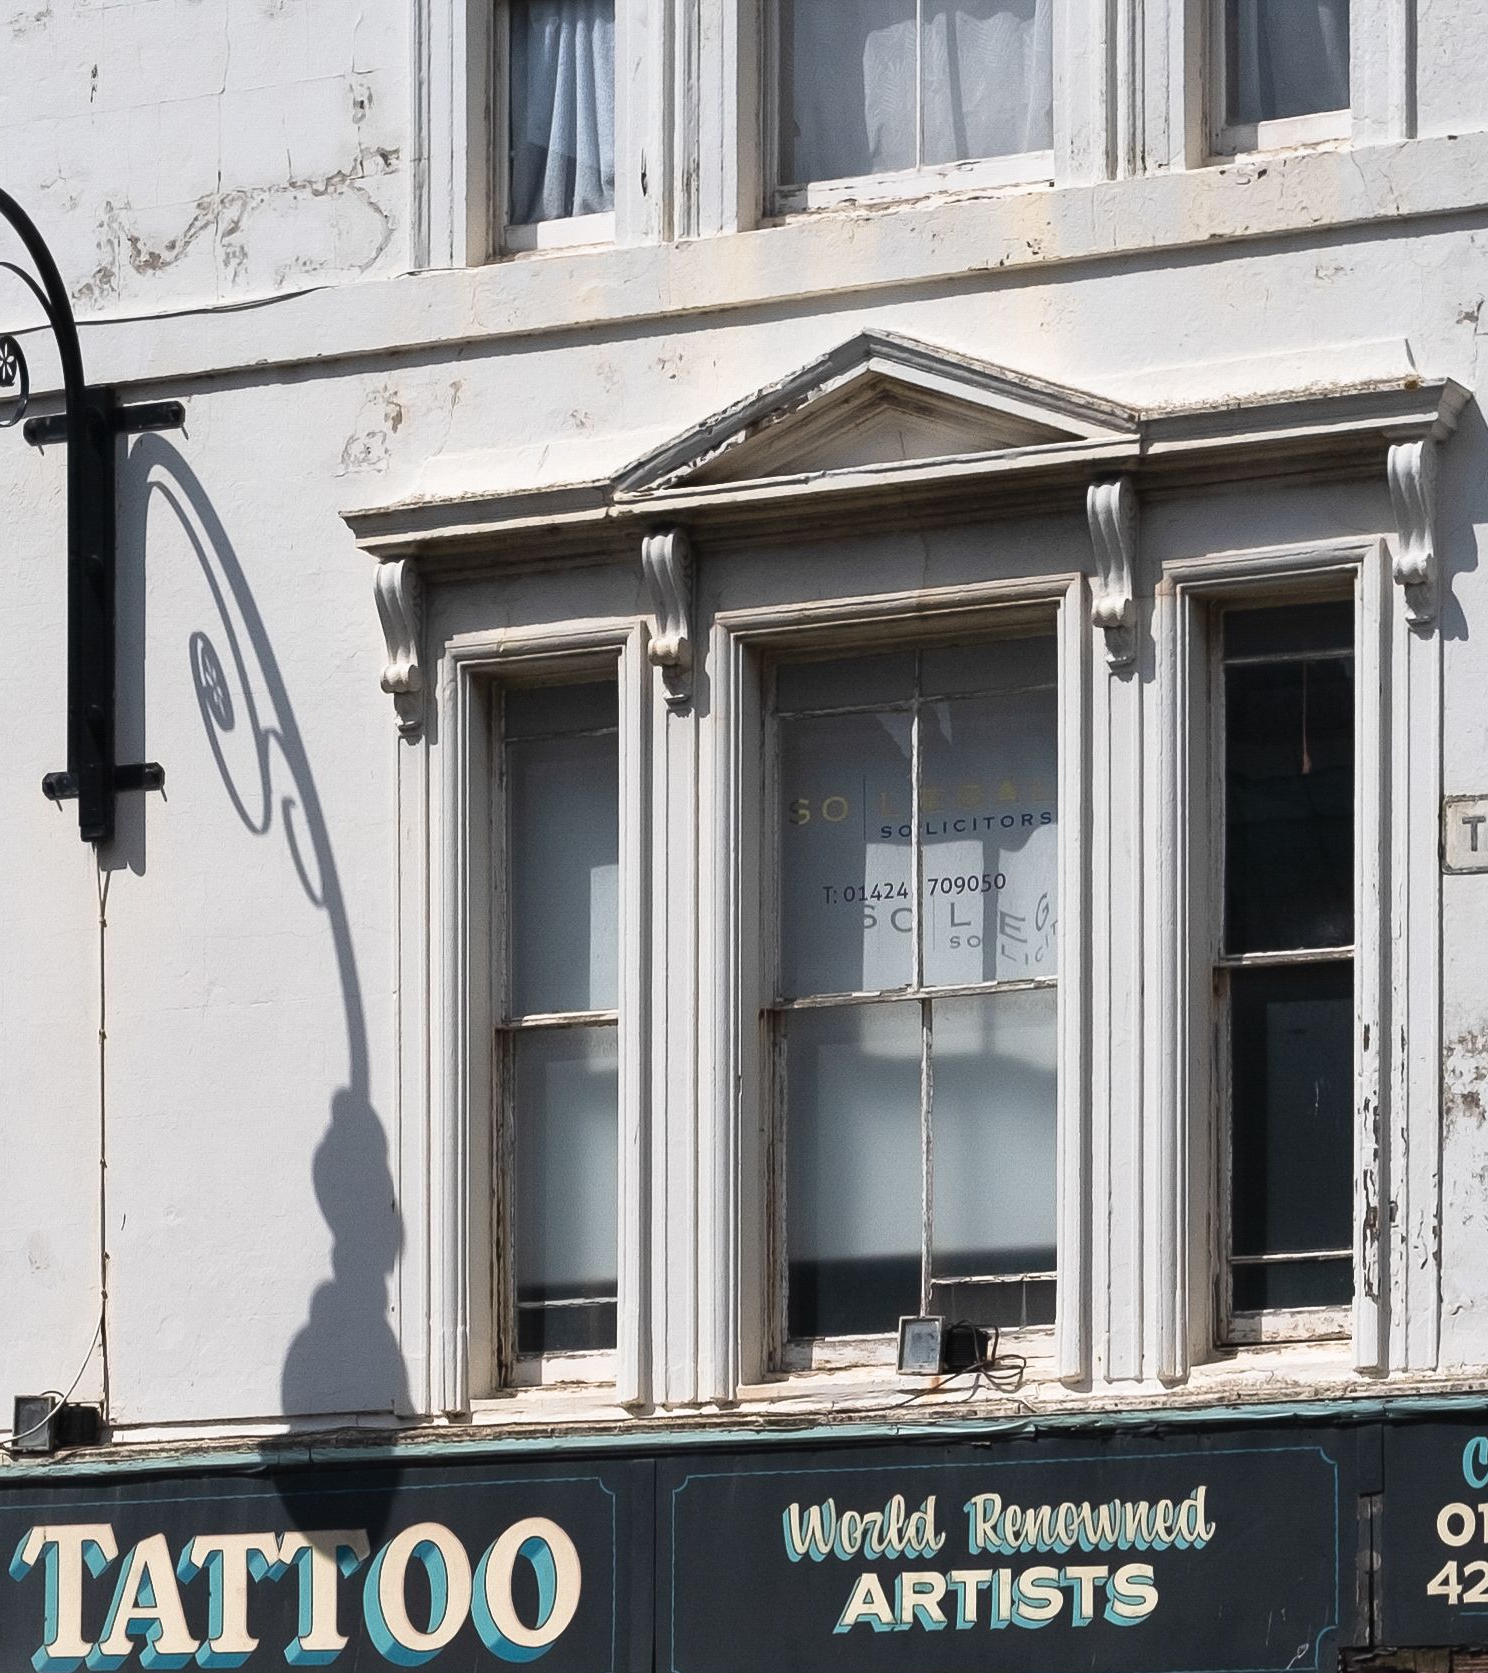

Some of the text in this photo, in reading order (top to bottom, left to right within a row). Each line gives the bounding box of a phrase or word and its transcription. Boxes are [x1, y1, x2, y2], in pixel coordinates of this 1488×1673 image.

[880, 811, 1052, 839] SOLICITORS
[843, 881, 909, 903] 01424
[927, 872, 1006, 897] 709050
[782, 1483, 1217, 1563] World Renowned
[832, 1562, 1161, 1635] ARTISTS
